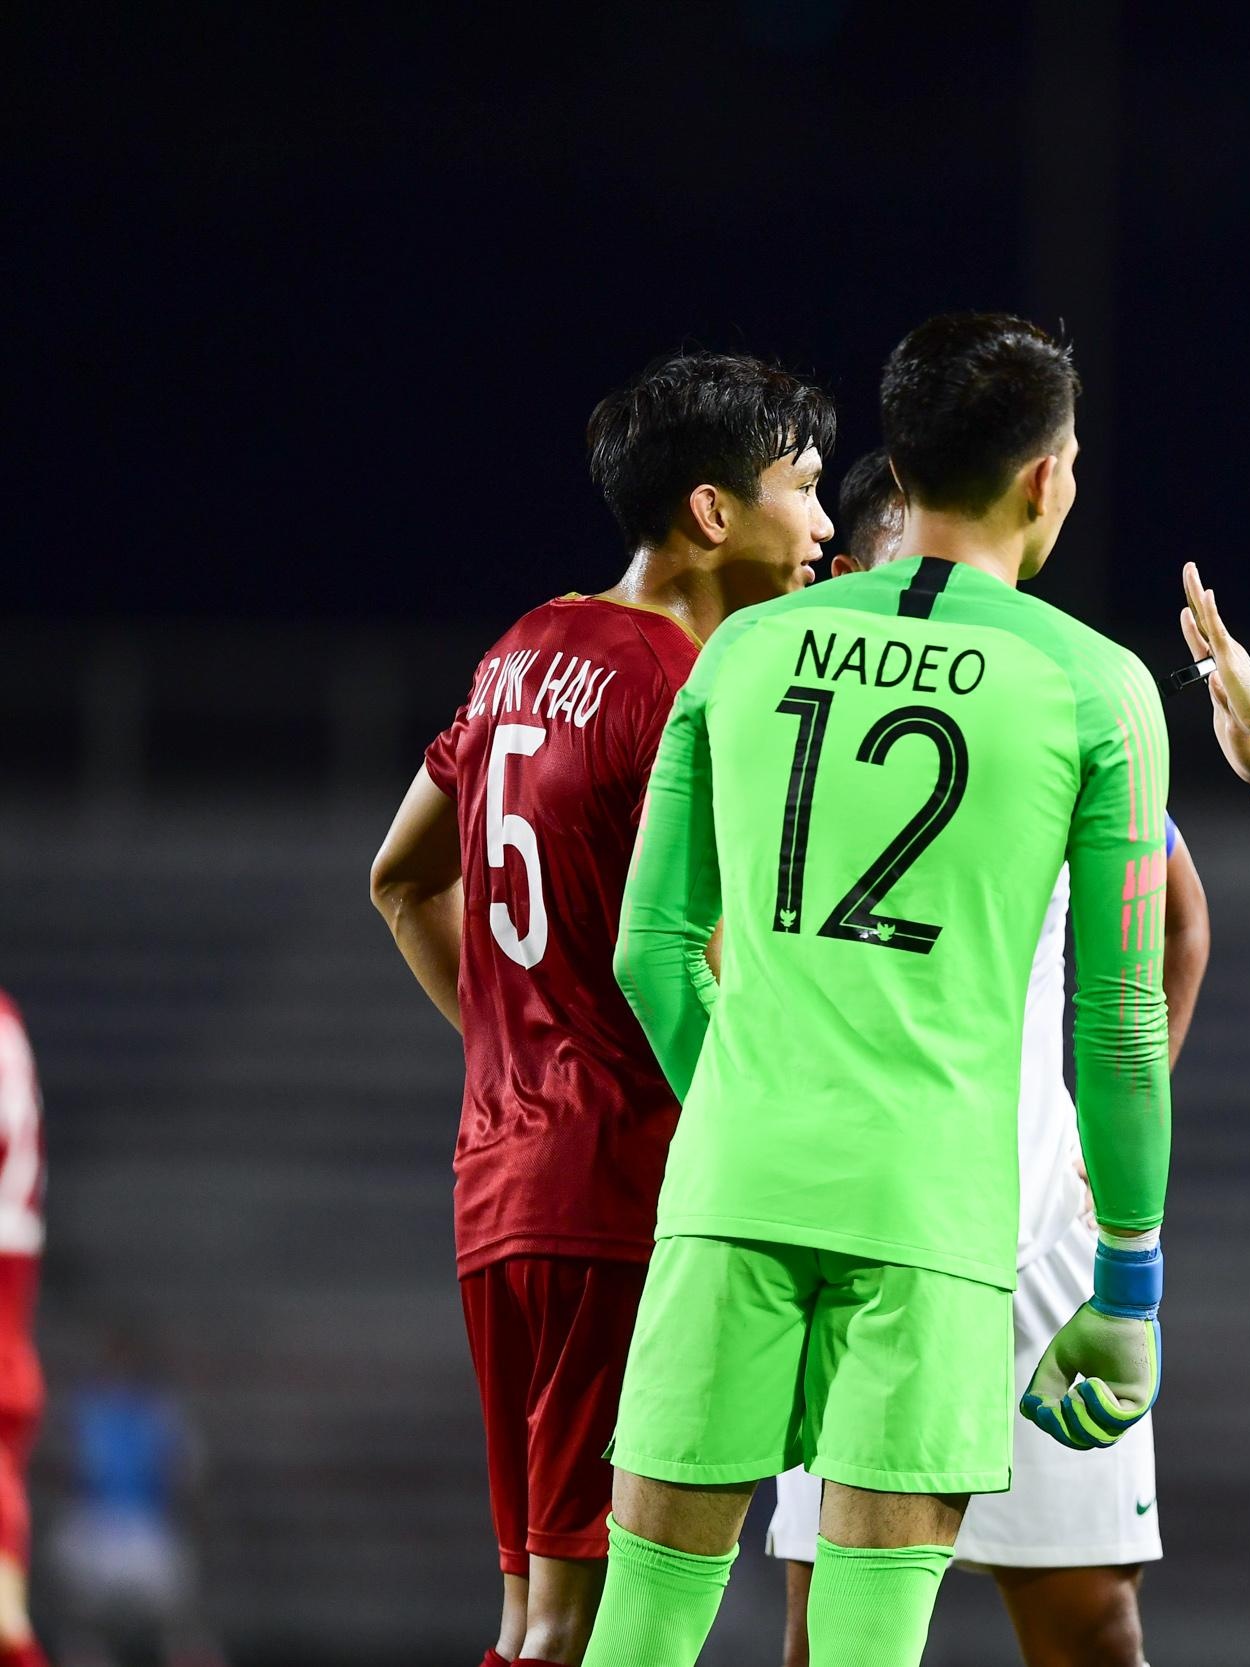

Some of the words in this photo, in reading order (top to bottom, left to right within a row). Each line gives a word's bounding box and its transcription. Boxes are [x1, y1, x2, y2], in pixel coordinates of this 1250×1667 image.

[531, 651, 617, 728] HAU
[794, 629, 985, 695] NADEO
[486, 723, 548, 970] 5
[772, 685, 969, 955] 12
